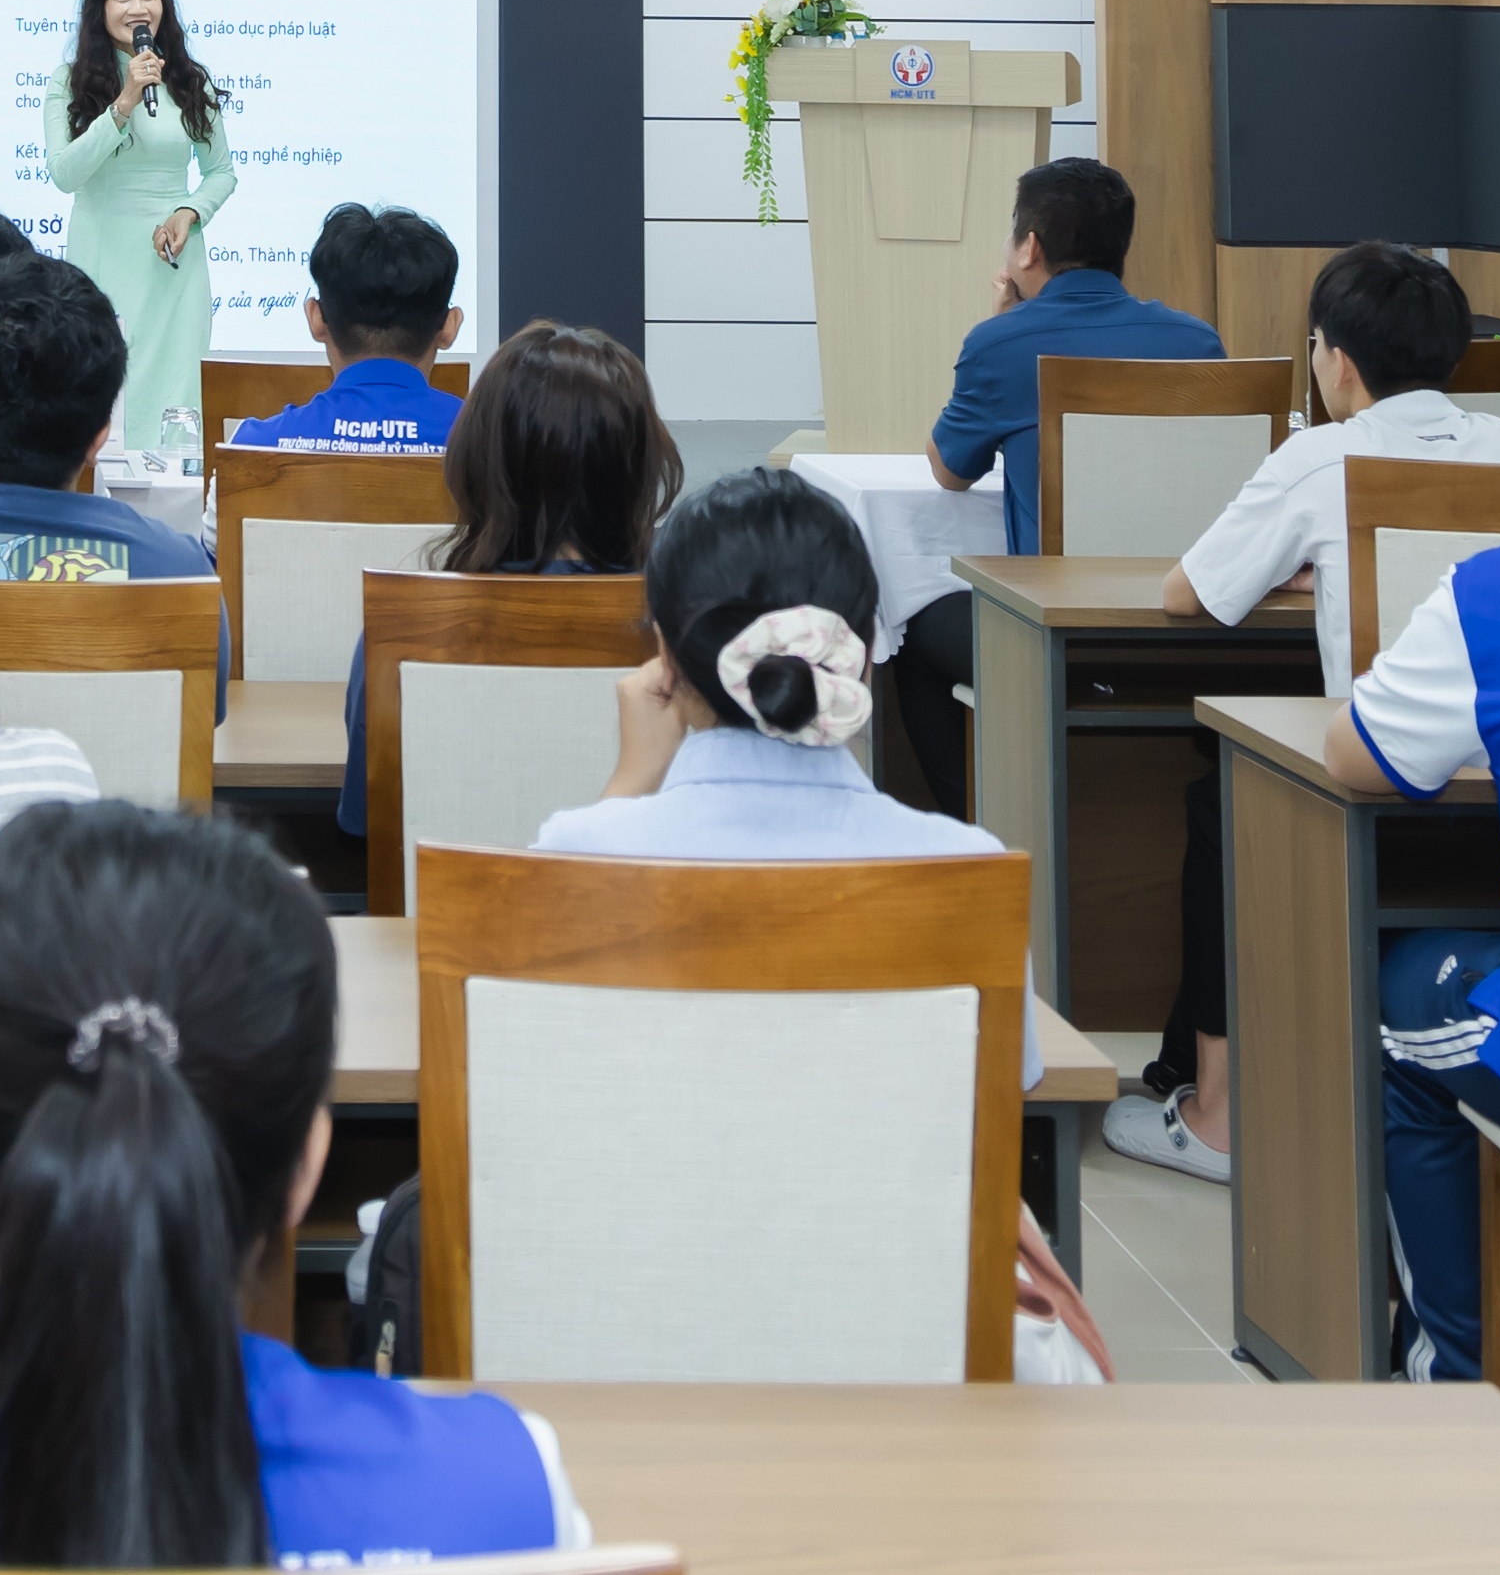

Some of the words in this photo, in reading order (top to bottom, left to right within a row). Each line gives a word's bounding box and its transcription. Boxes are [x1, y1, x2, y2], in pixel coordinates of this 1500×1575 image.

[16, 18, 58, 35] Tuyên
[203, 20, 234, 39] giáo
[238, 21, 264, 39] dục
[268, 22, 304, 40] pháp
[308, 22, 336, 39] luật
[238, 73, 272, 89] thần
[16, 94, 41, 108] cho
[16, 143, 40, 158] Kết
[252, 145, 288, 164] nghề
[293, 148, 342, 166] nghiệp
[15, 169, 31, 181] và
[209, 246, 243, 263] Gòn,
[248, 247, 295, 262] Thành
[228, 290, 252, 308] của
[258, 291, 299, 316] người
